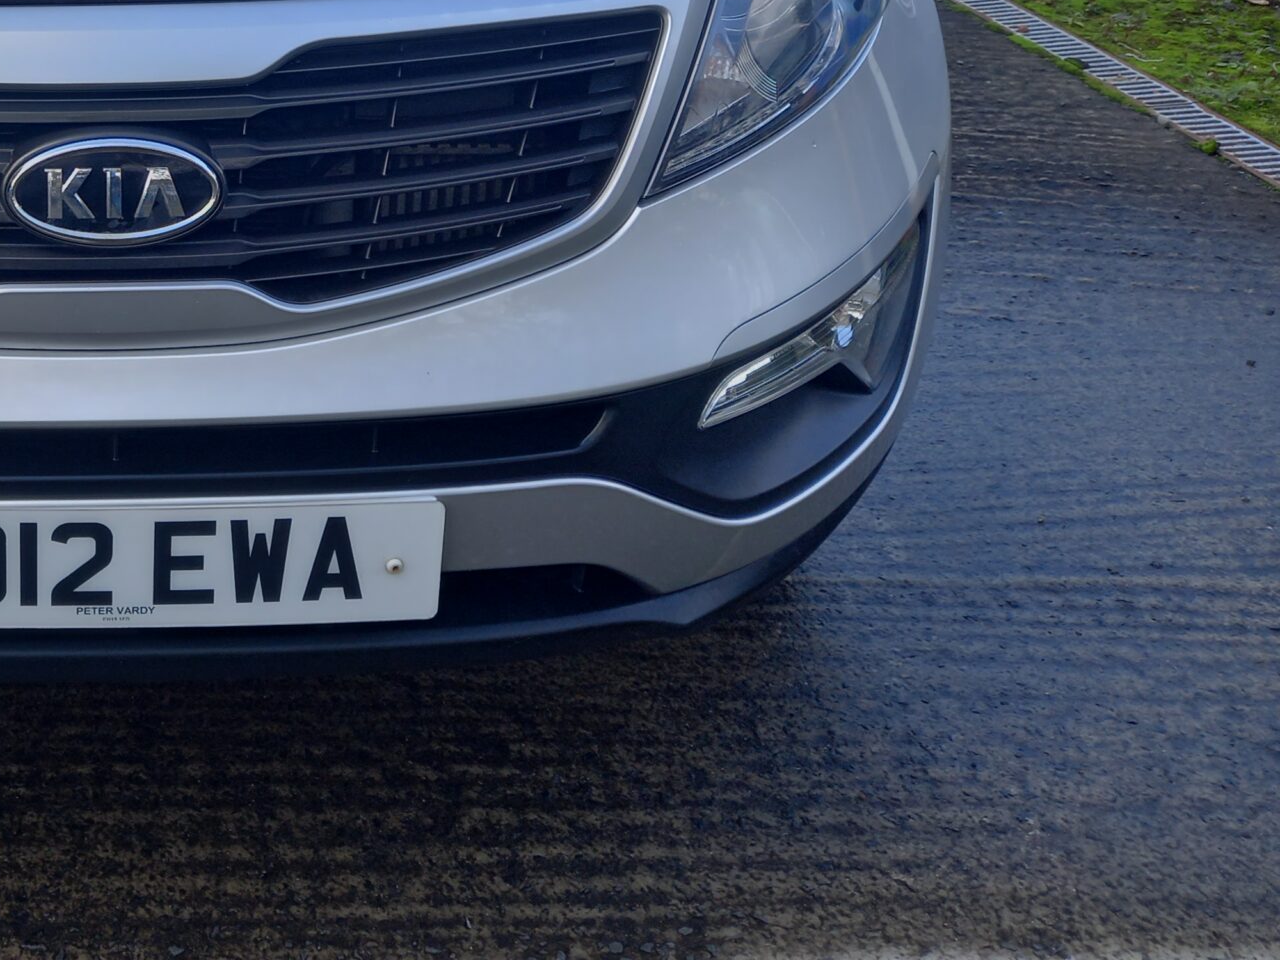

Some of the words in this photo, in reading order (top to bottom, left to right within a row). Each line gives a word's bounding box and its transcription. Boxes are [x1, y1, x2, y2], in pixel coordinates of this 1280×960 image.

[44, 166, 186, 220] KIA
[153, 516, 364, 606] EWA
[76, 606, 114, 616] PETER
[116, 606, 156, 616] VARDY
